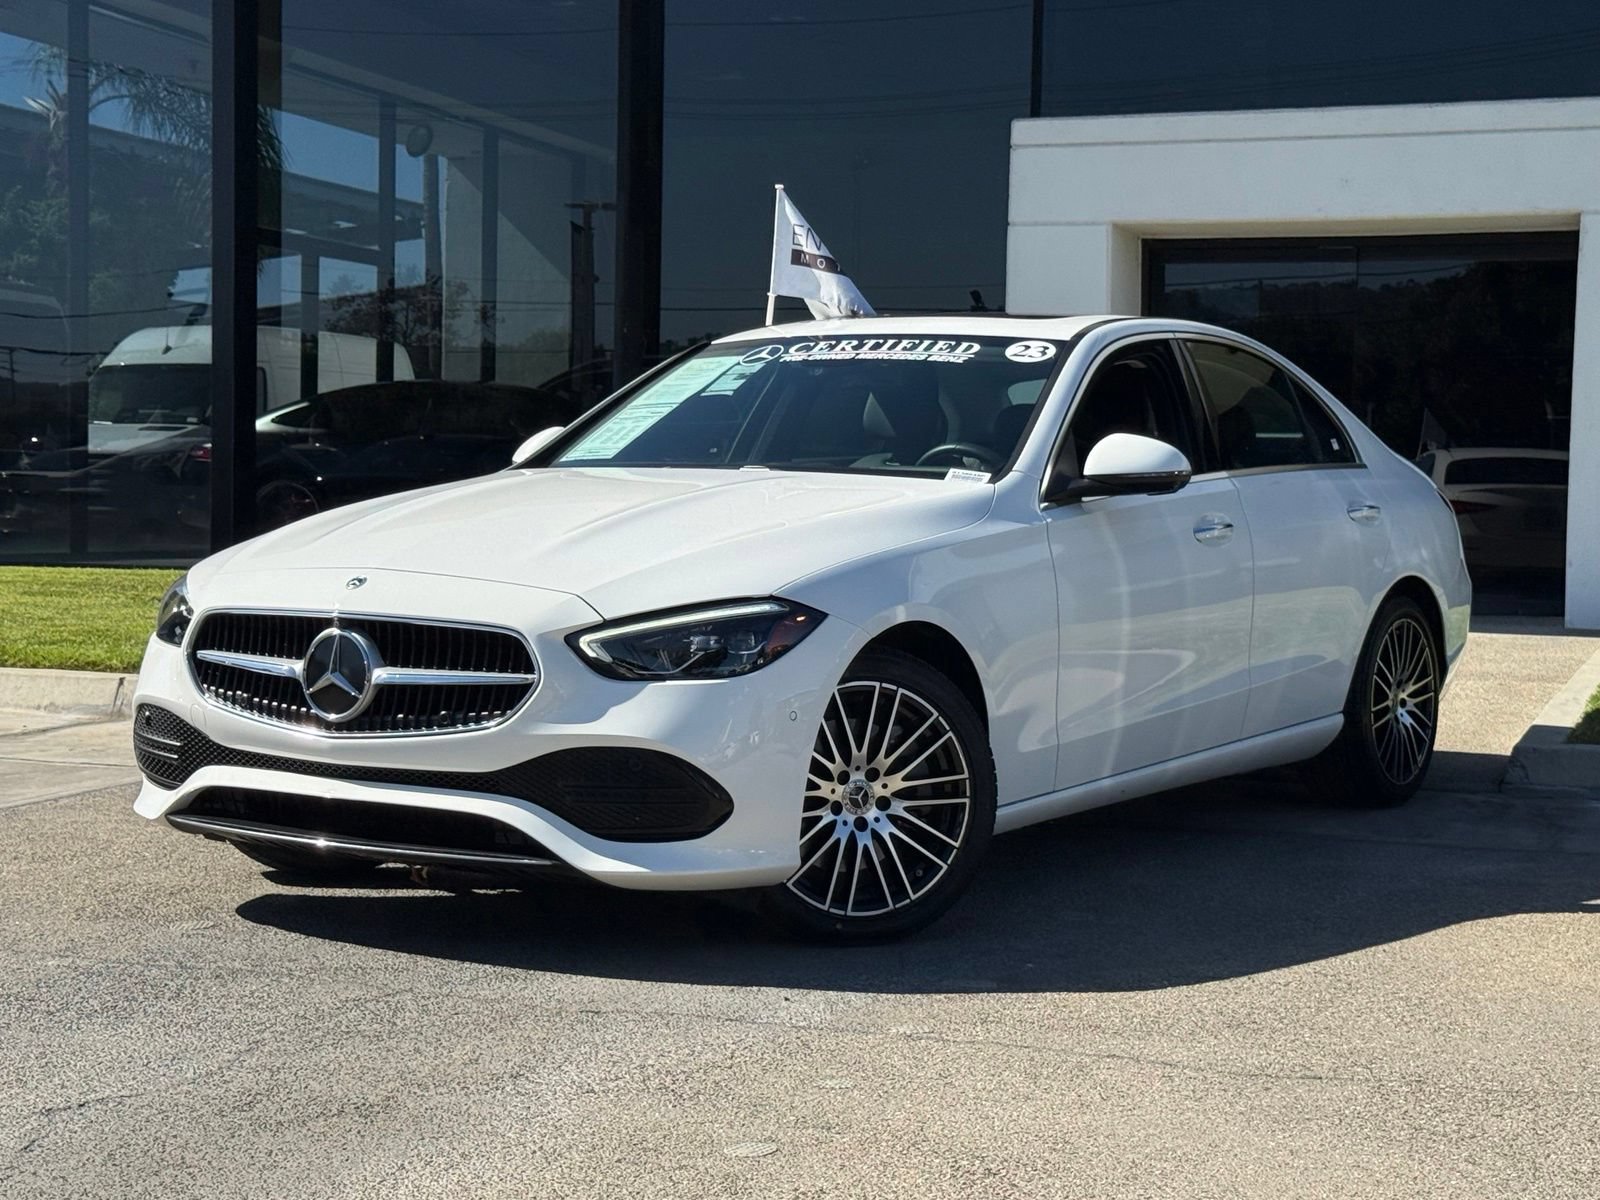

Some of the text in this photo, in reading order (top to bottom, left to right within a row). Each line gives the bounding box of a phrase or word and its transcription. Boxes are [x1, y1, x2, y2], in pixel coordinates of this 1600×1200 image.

[788, 339, 981, 354] CERTIFIED
[1009, 344, 1050, 359] 23
[854, 353, 928, 361] MERCEDES
[927, 354, 968, 363] BENZ
